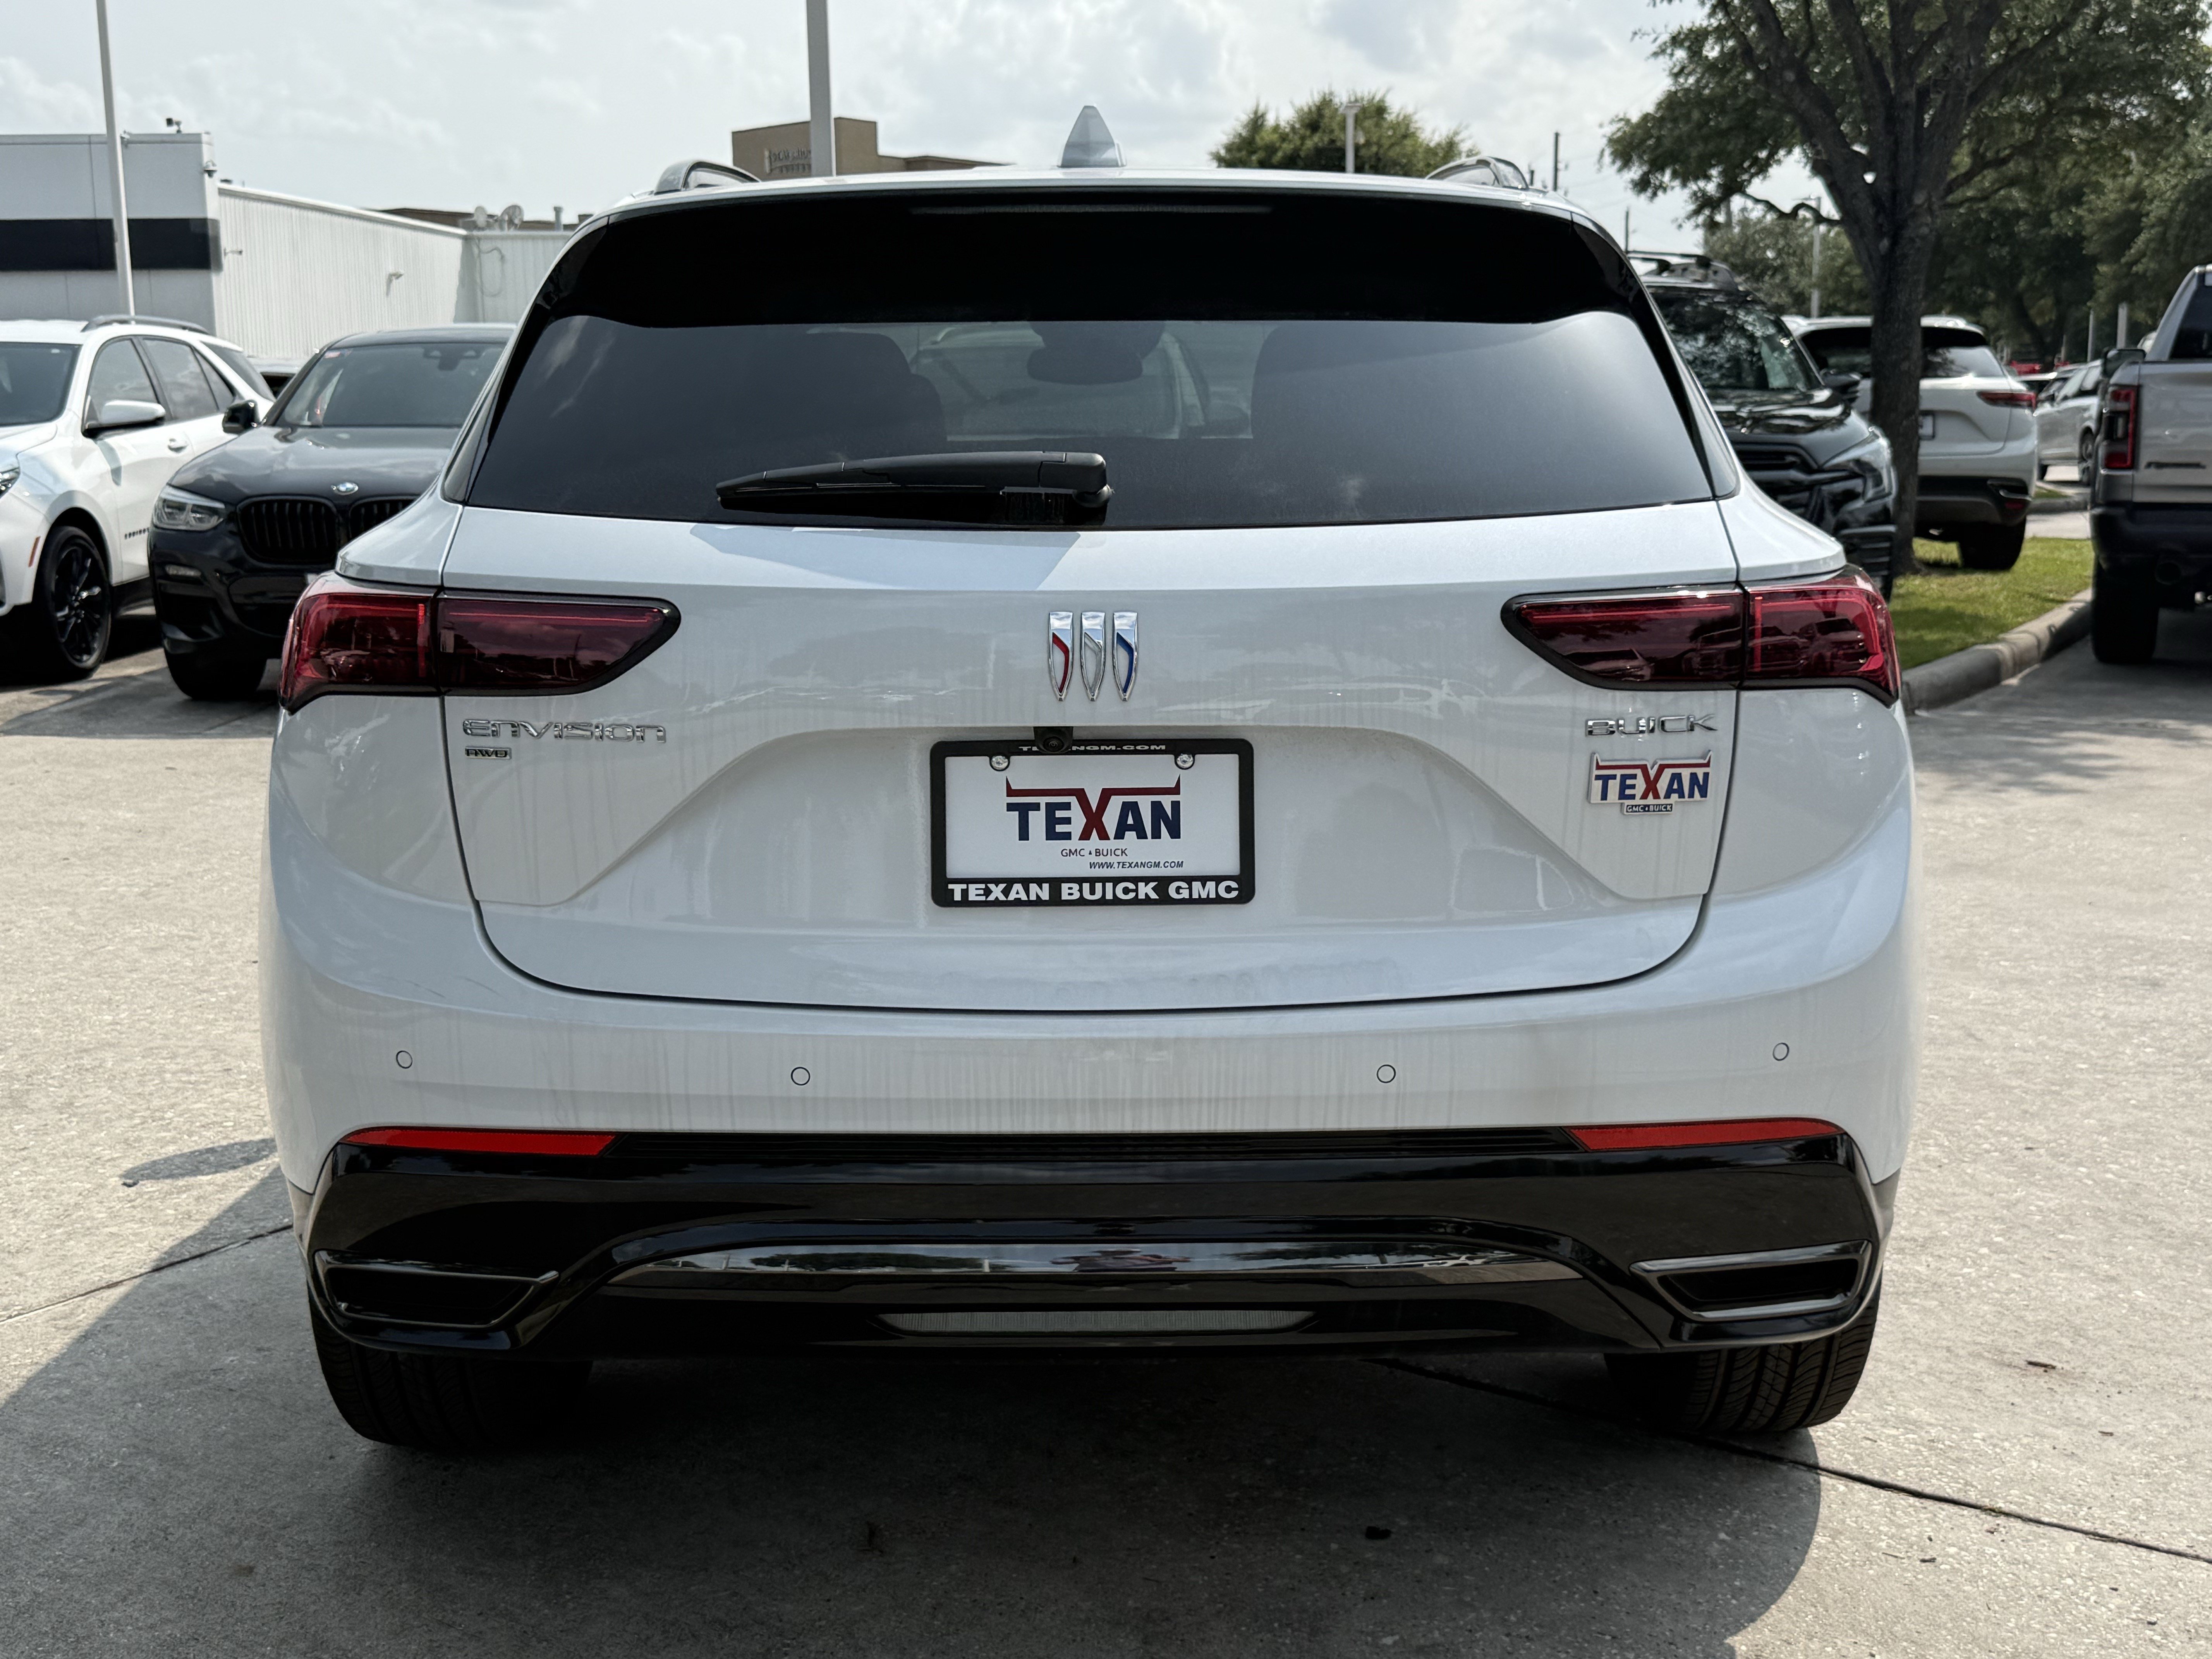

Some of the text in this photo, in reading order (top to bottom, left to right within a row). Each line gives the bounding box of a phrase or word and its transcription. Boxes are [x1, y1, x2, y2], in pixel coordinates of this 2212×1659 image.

[462, 719, 666, 743] ENVISION
[1585, 714, 1718, 737] BUICK
[466, 749, 508, 757] AWD
[1594, 763, 1711, 801] TEXAN
[1006, 788, 1181, 841] TEXAN
[1061, 848, 1128, 857] GMC BUICK
[1089, 860, 1184, 869] WWW.TEXANGM.COM
[948, 880, 1239, 901] TEXAN BUICK GMC
